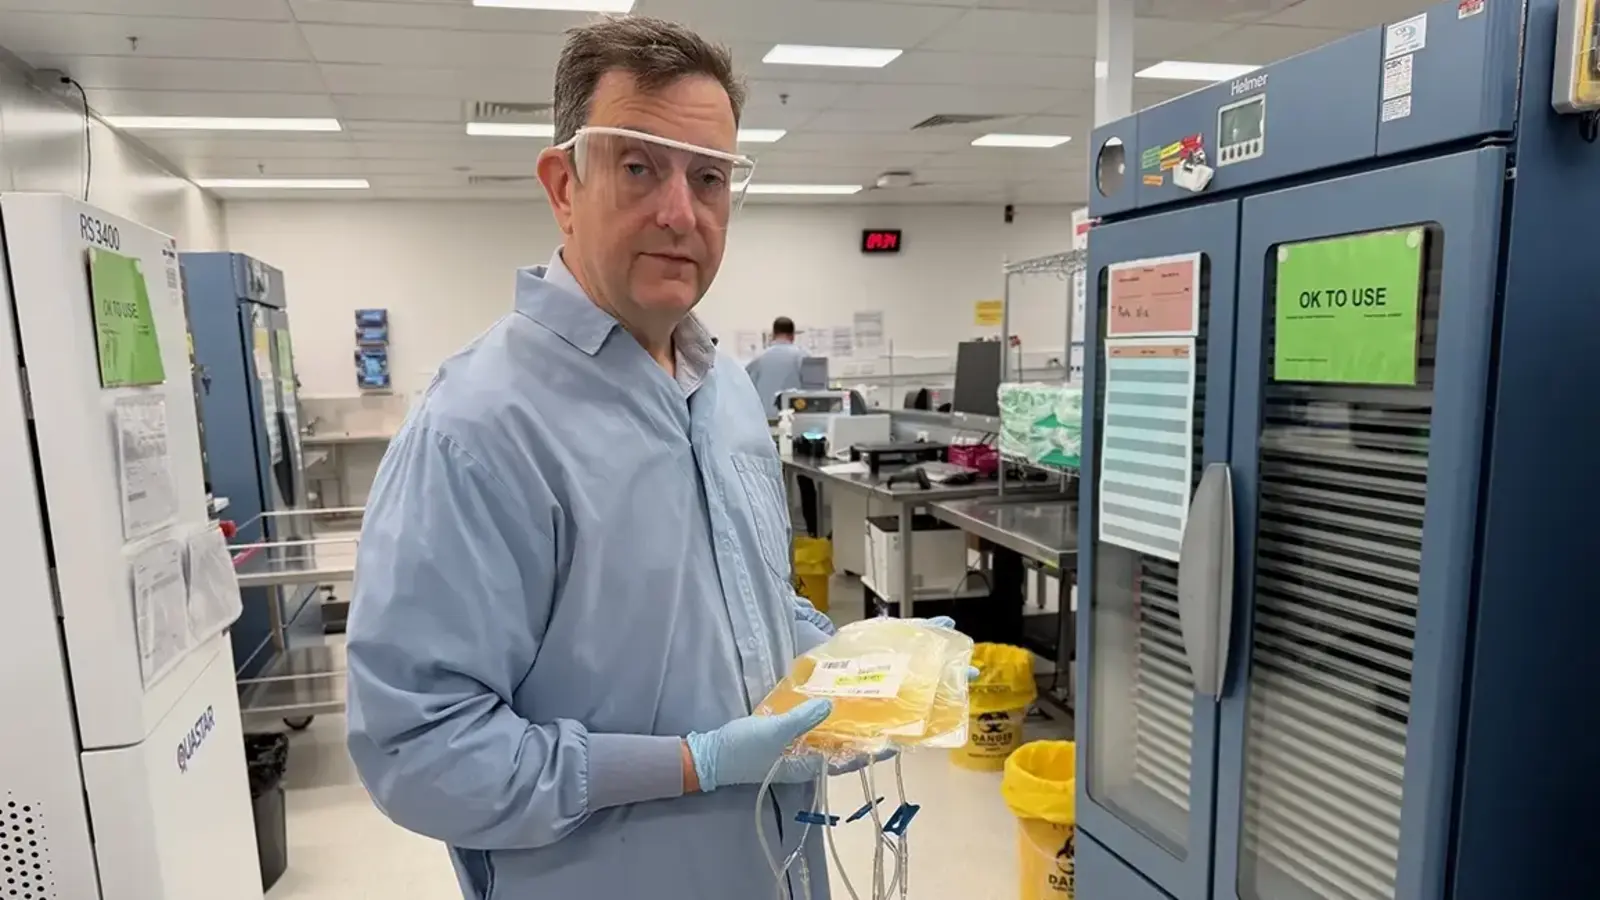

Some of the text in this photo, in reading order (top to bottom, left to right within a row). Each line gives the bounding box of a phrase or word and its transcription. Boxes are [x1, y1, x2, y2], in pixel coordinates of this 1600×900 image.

[1231, 74, 1269, 96] Helmer
[1299, 287, 1387, 308] OK TO USE
[121, 303, 140, 319] USE
